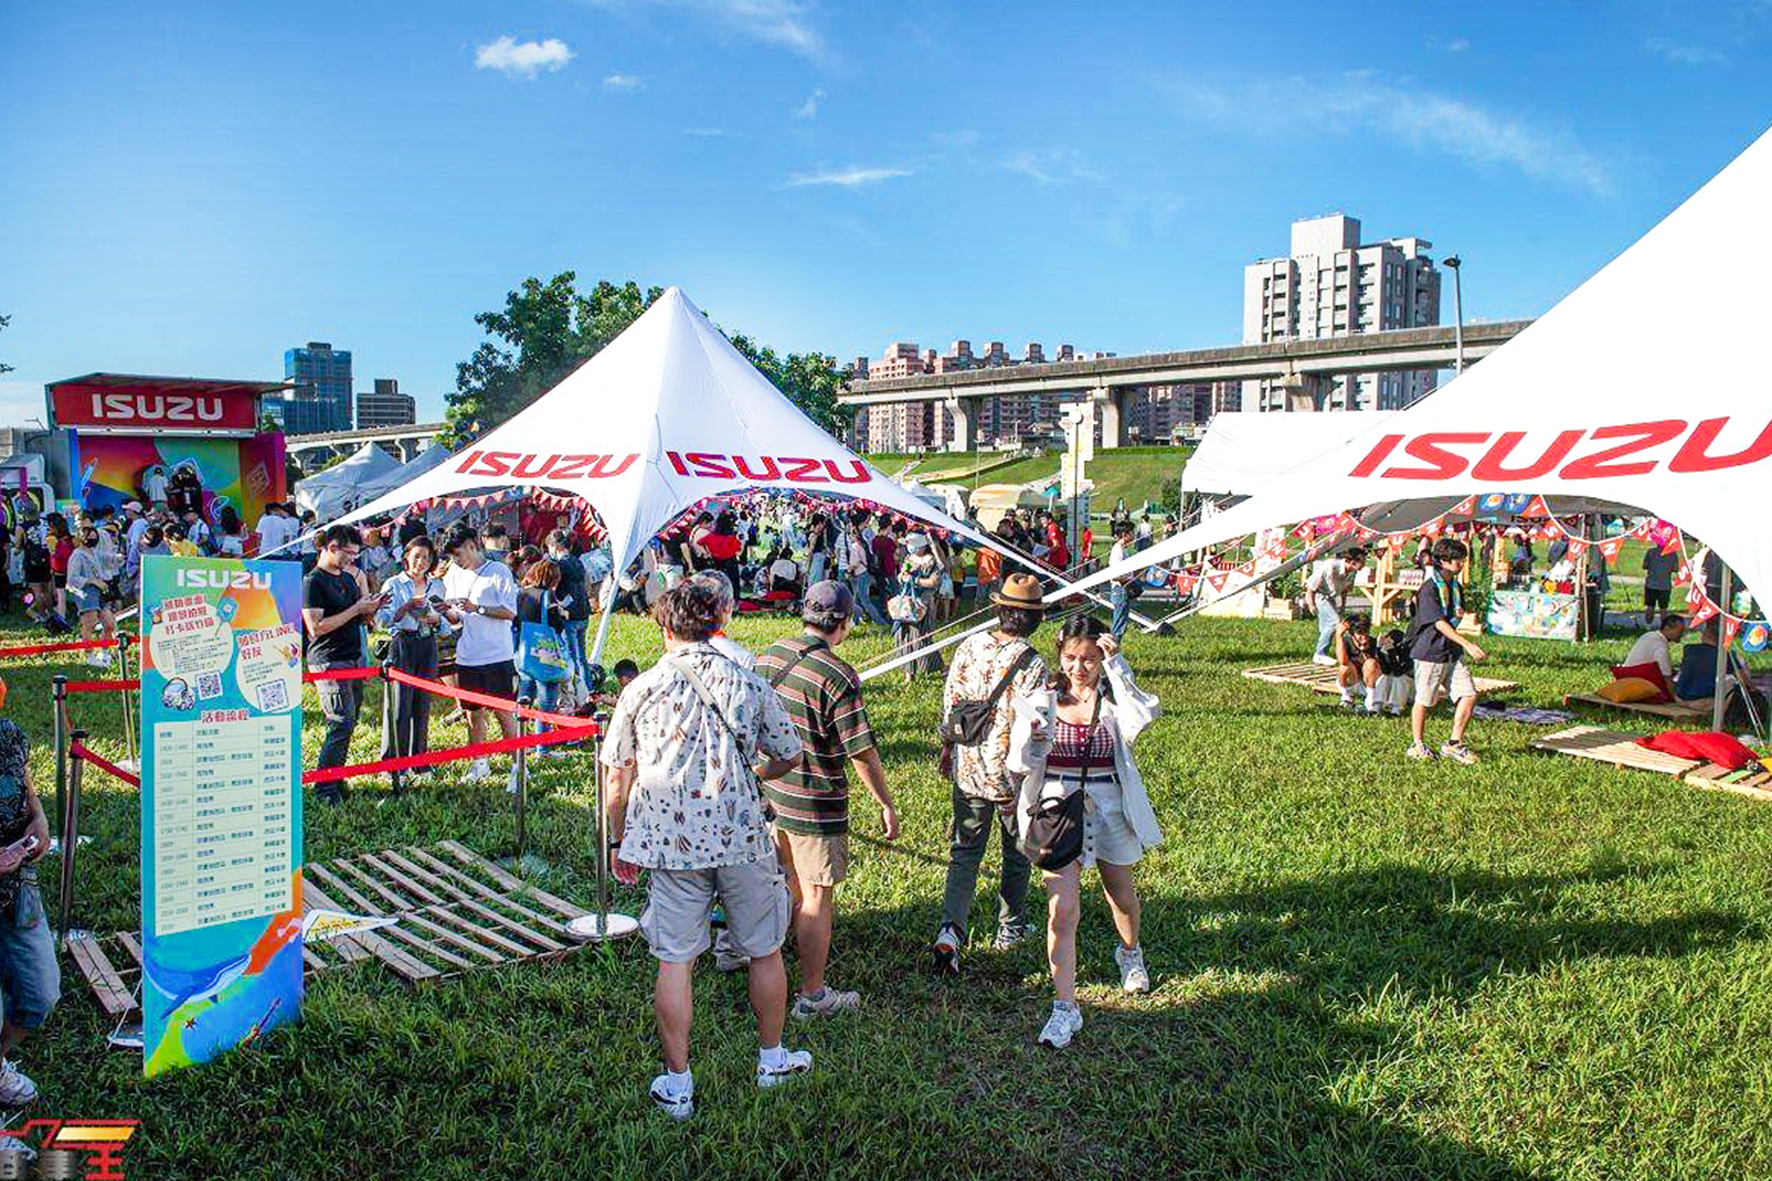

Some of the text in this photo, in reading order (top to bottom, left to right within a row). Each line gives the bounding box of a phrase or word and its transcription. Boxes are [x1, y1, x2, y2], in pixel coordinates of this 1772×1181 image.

[92, 393, 224, 421] ISUZU
[1348, 416, 1772, 482] ISUZU
[455, 450, 640, 480] ISUZU
[666, 451, 872, 483] ISUZU
[178, 569, 272, 590] ISUZU
[201, 711, 249, 724] 活動流程
